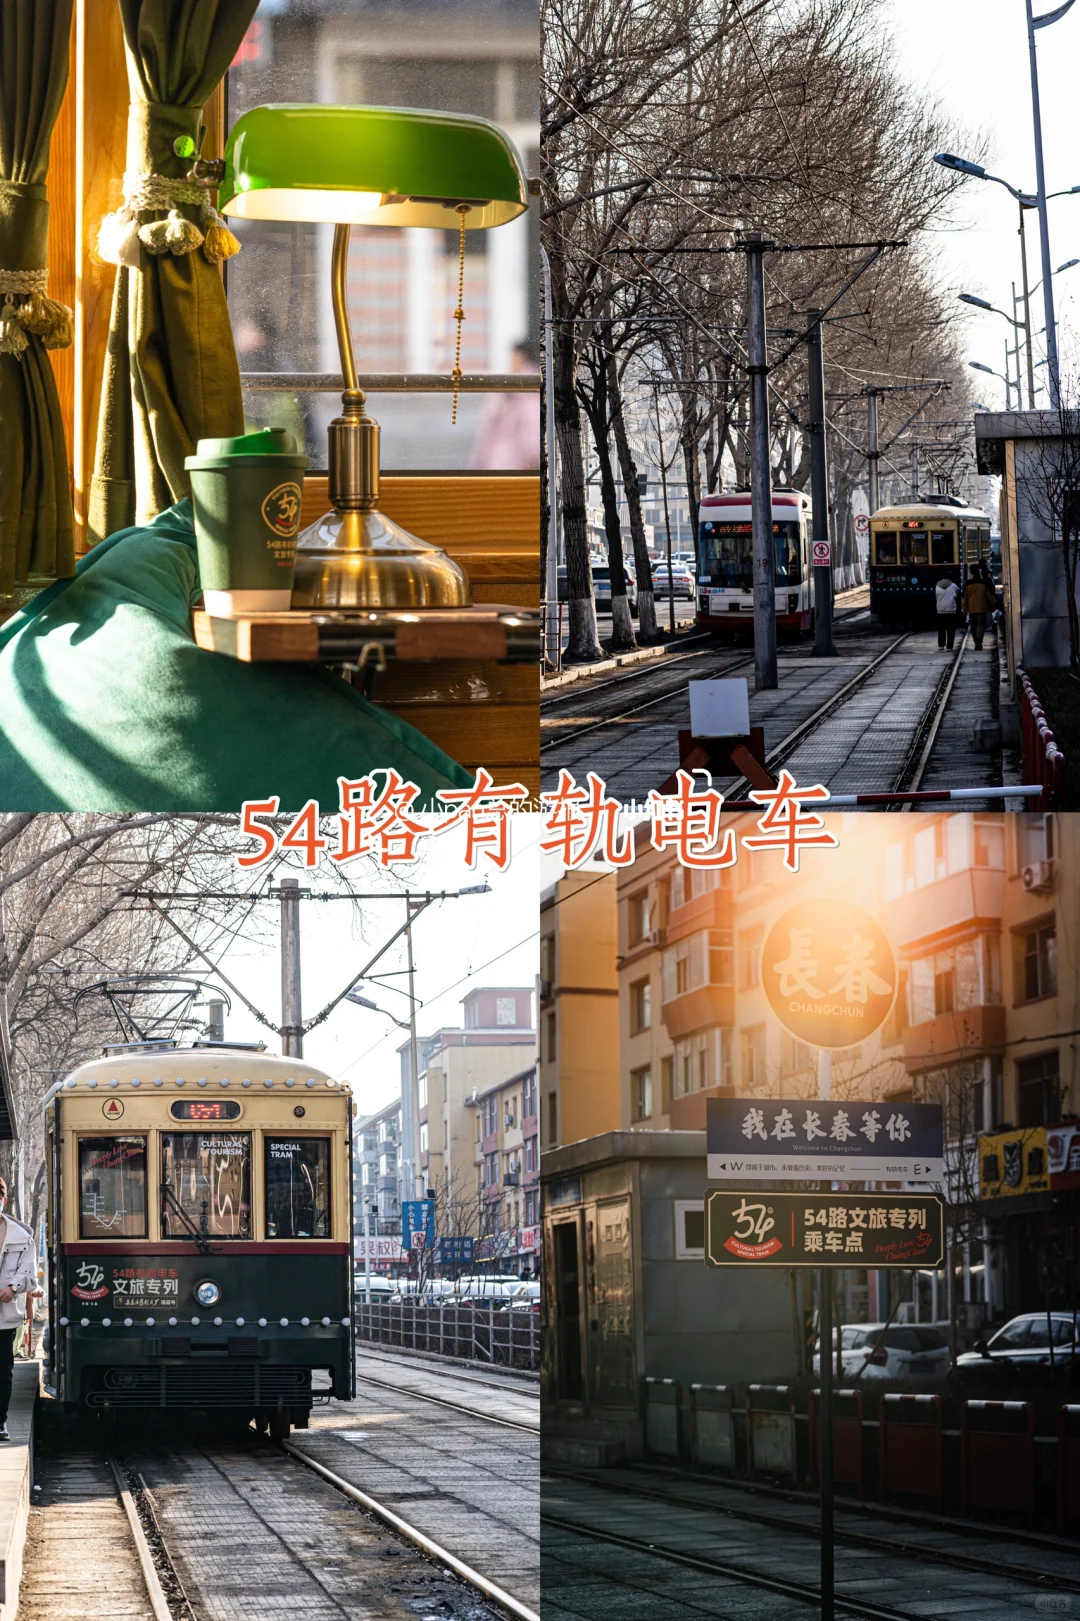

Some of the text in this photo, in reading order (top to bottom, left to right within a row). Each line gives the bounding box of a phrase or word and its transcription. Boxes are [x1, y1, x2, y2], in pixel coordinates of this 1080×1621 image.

[788, 1002, 864, 1018] CHANGCHUN
[741, 1107, 912, 1143] 我在长春等你
[201, 1141, 243, 1149] CULTURAL
[270, 1143, 301, 1151] SPECIAL
[792, 1144, 820, 1152] Welcome
[206, 1148, 243, 1156] TOURISM
[270, 1151, 293, 1159] TRAM
[730, 1161, 743, 1171] W
[914, 1164, 921, 1175] E
[803, 1207, 927, 1230] 54路文旅专列
[731, 1240, 775, 1252] CULTURAL TOURISM
[804, 1230, 864, 1253] 乘车点
[899, 1240, 916, 1249] Love
[737, 1249, 770, 1257] SPECIAL TRAM
[112, 1268, 179, 1279] 54路有轨电车
[112, 1279, 179, 1295] 文旅专列
